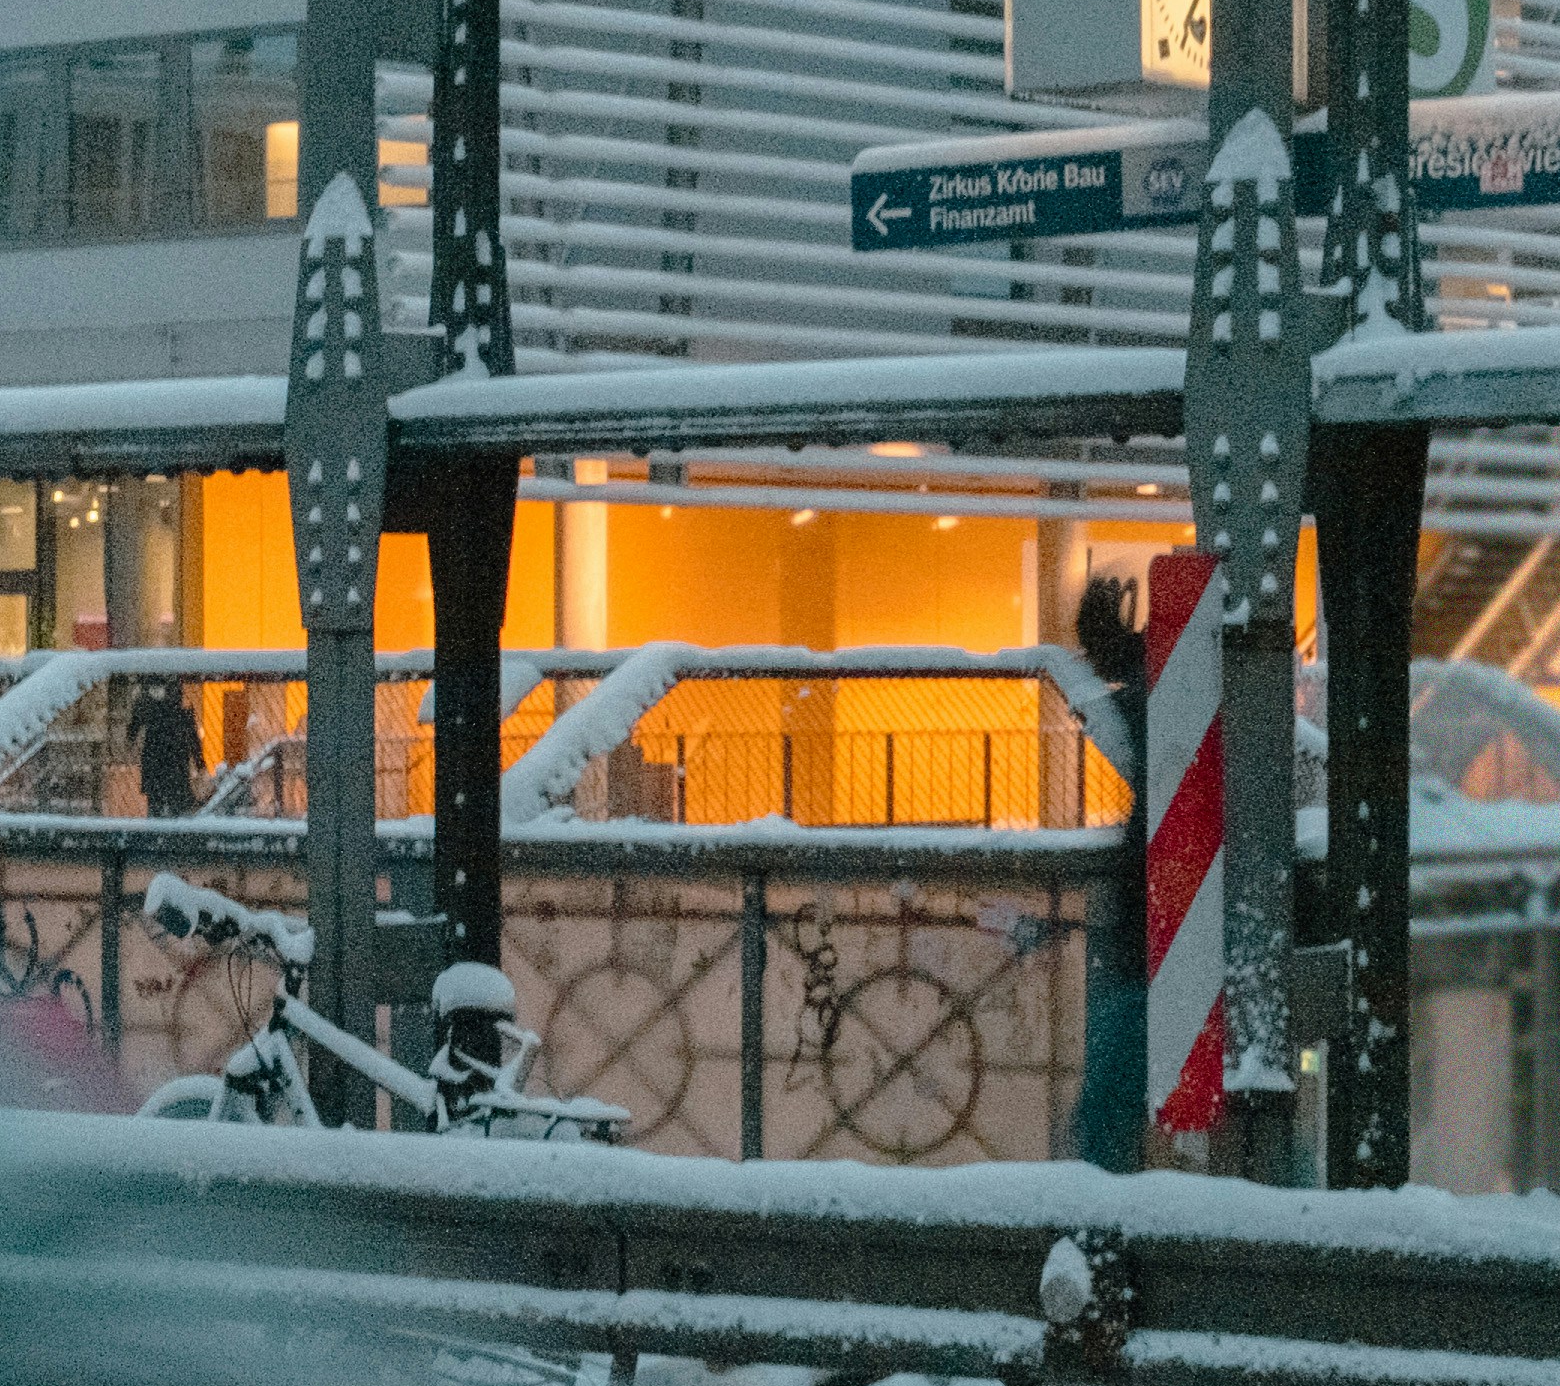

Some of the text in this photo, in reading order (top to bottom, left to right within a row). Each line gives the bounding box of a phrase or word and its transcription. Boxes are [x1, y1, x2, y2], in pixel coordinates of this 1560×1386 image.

[929, 173, 992, 202] Zirkus
[1063, 163, 1106, 190] Bau
[930, 201, 1037, 232] Finanzamt
